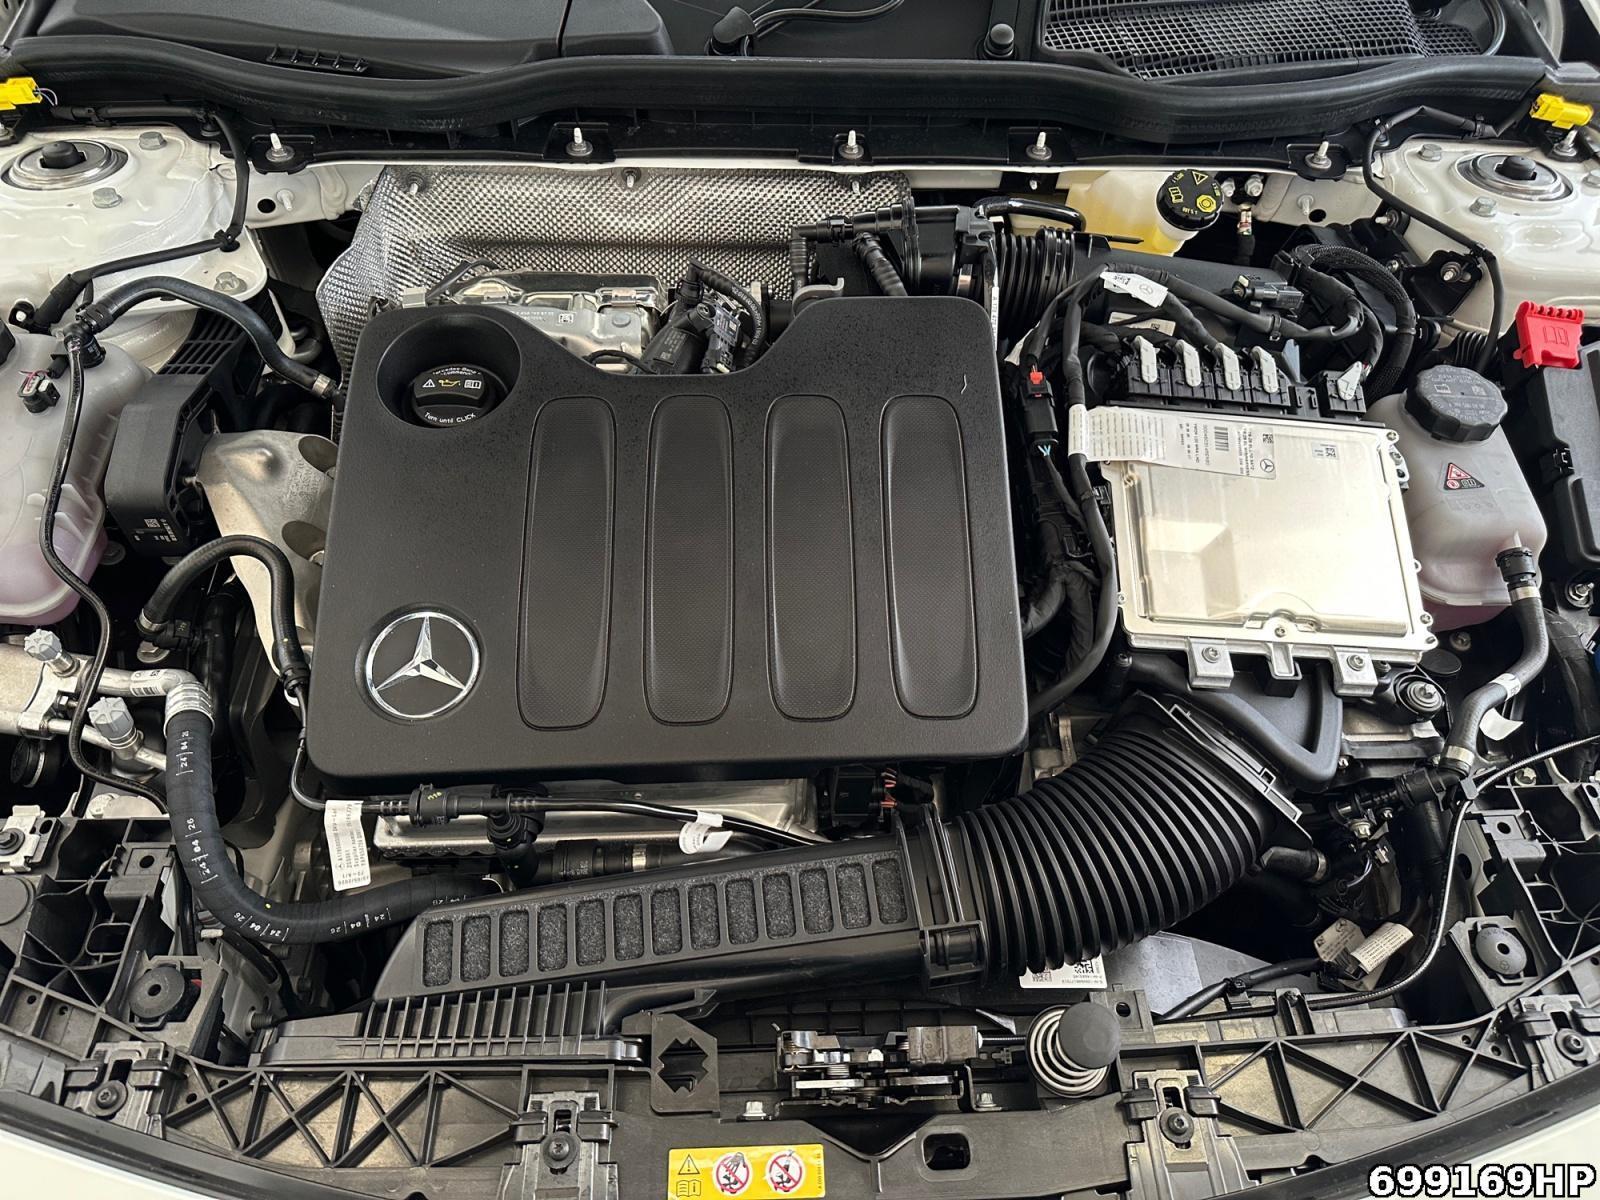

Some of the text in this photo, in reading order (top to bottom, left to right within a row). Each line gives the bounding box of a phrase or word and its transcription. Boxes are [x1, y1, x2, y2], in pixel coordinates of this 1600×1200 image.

[424, 411, 438, 421] Turn
[456, 412, 477, 423] CLICK
[186, 817, 196, 831] 26
[233, 912, 246, 922] 26
[350, 921, 361, 929] 04
